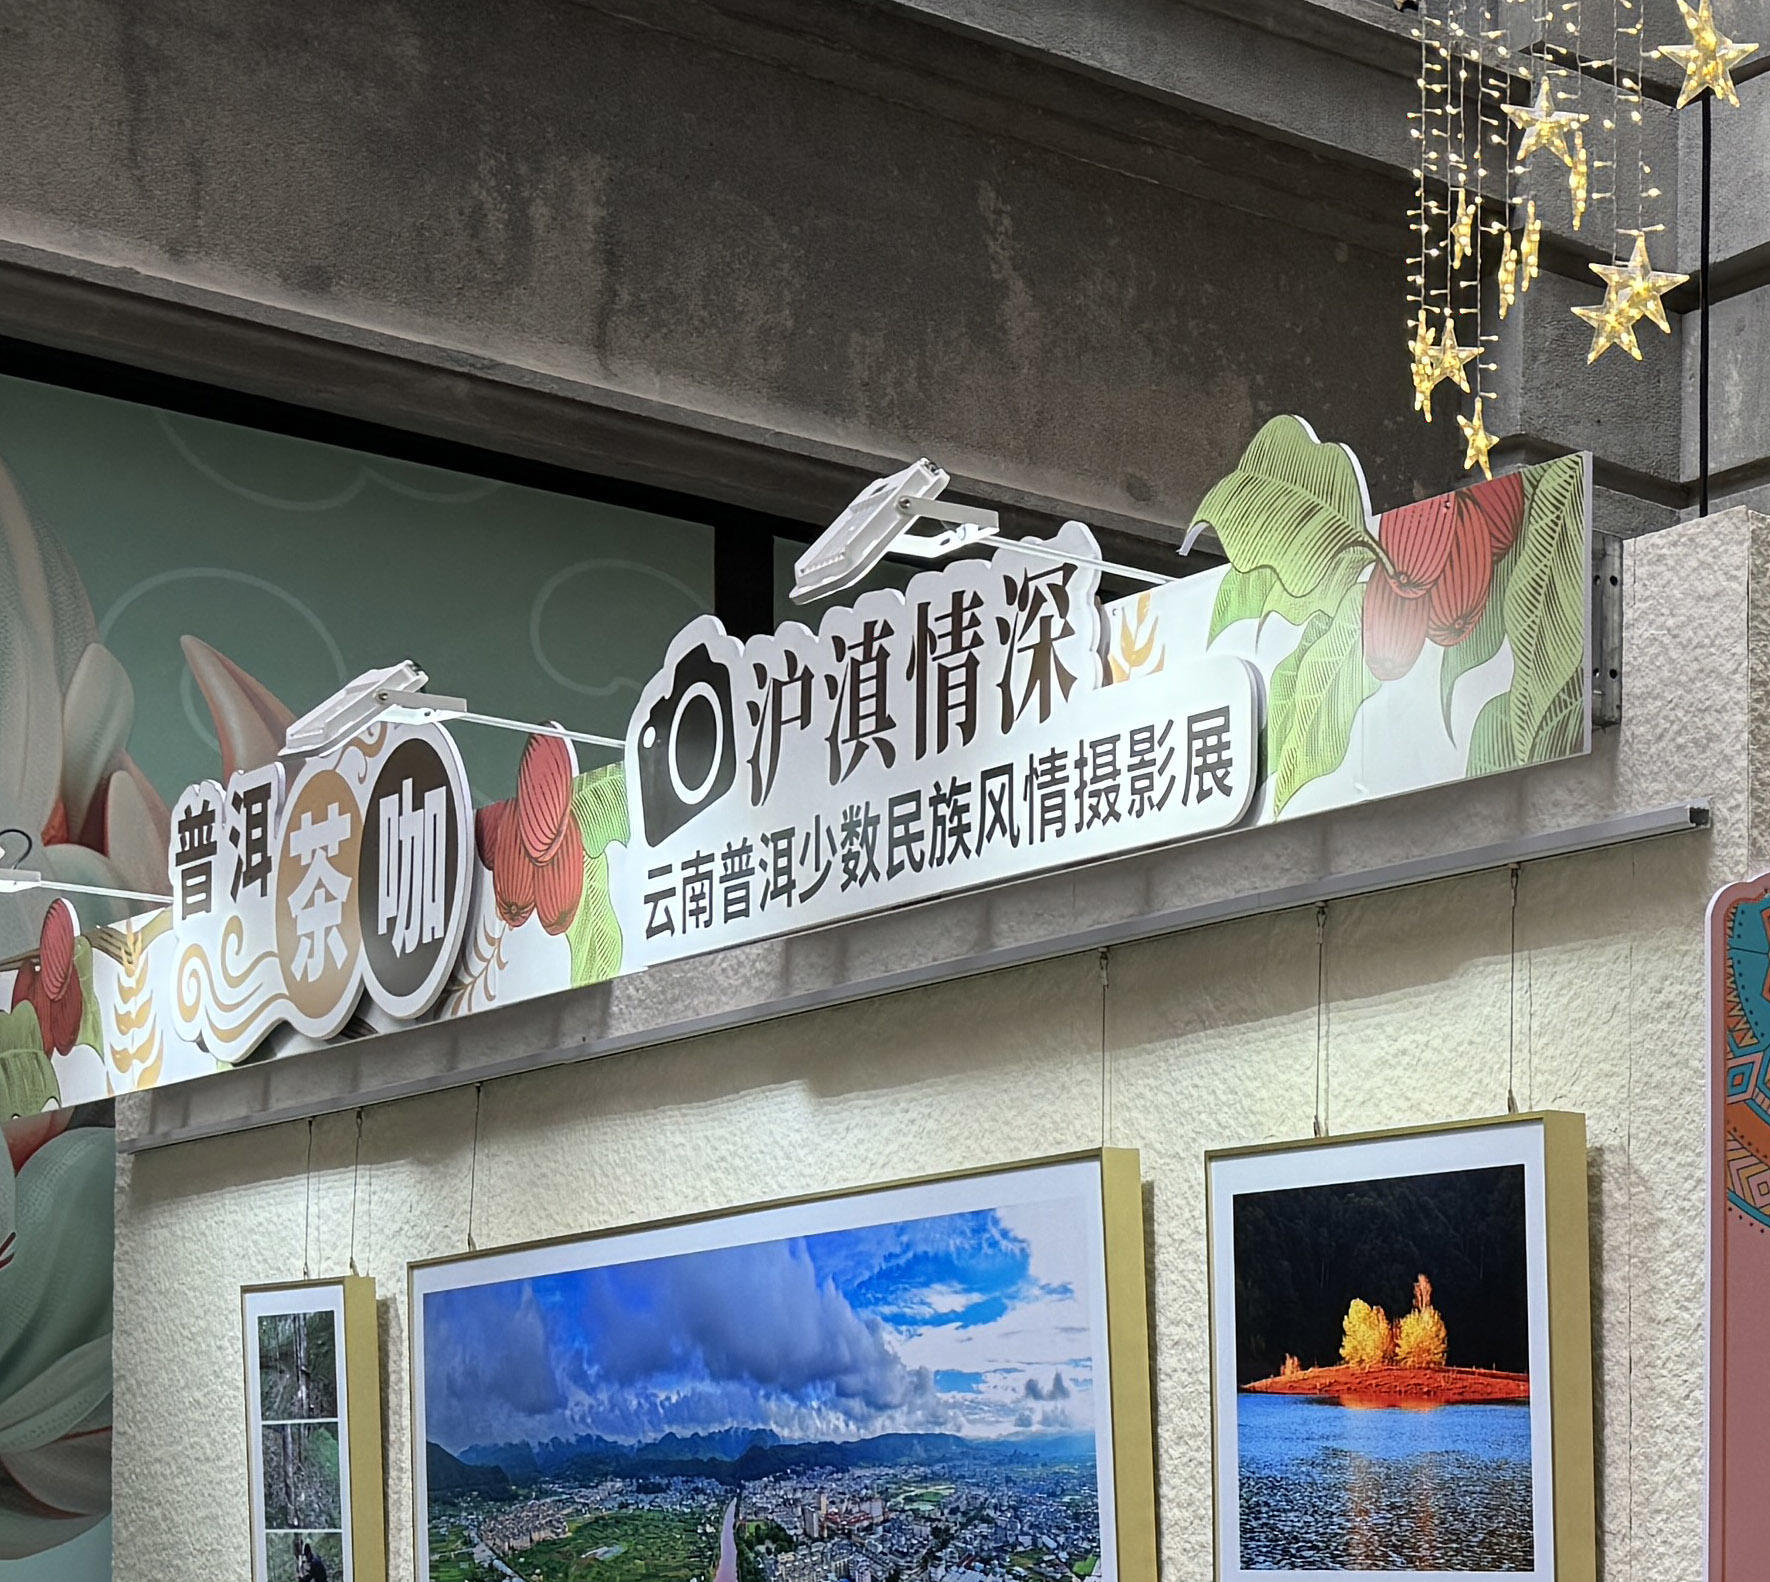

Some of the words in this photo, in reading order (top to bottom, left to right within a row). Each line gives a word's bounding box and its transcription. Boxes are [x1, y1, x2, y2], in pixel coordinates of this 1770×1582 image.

[745, 562, 1079, 808] 沪滇情深
[642, 705, 1235, 942] 云南普洱少数民族风情摄影展
